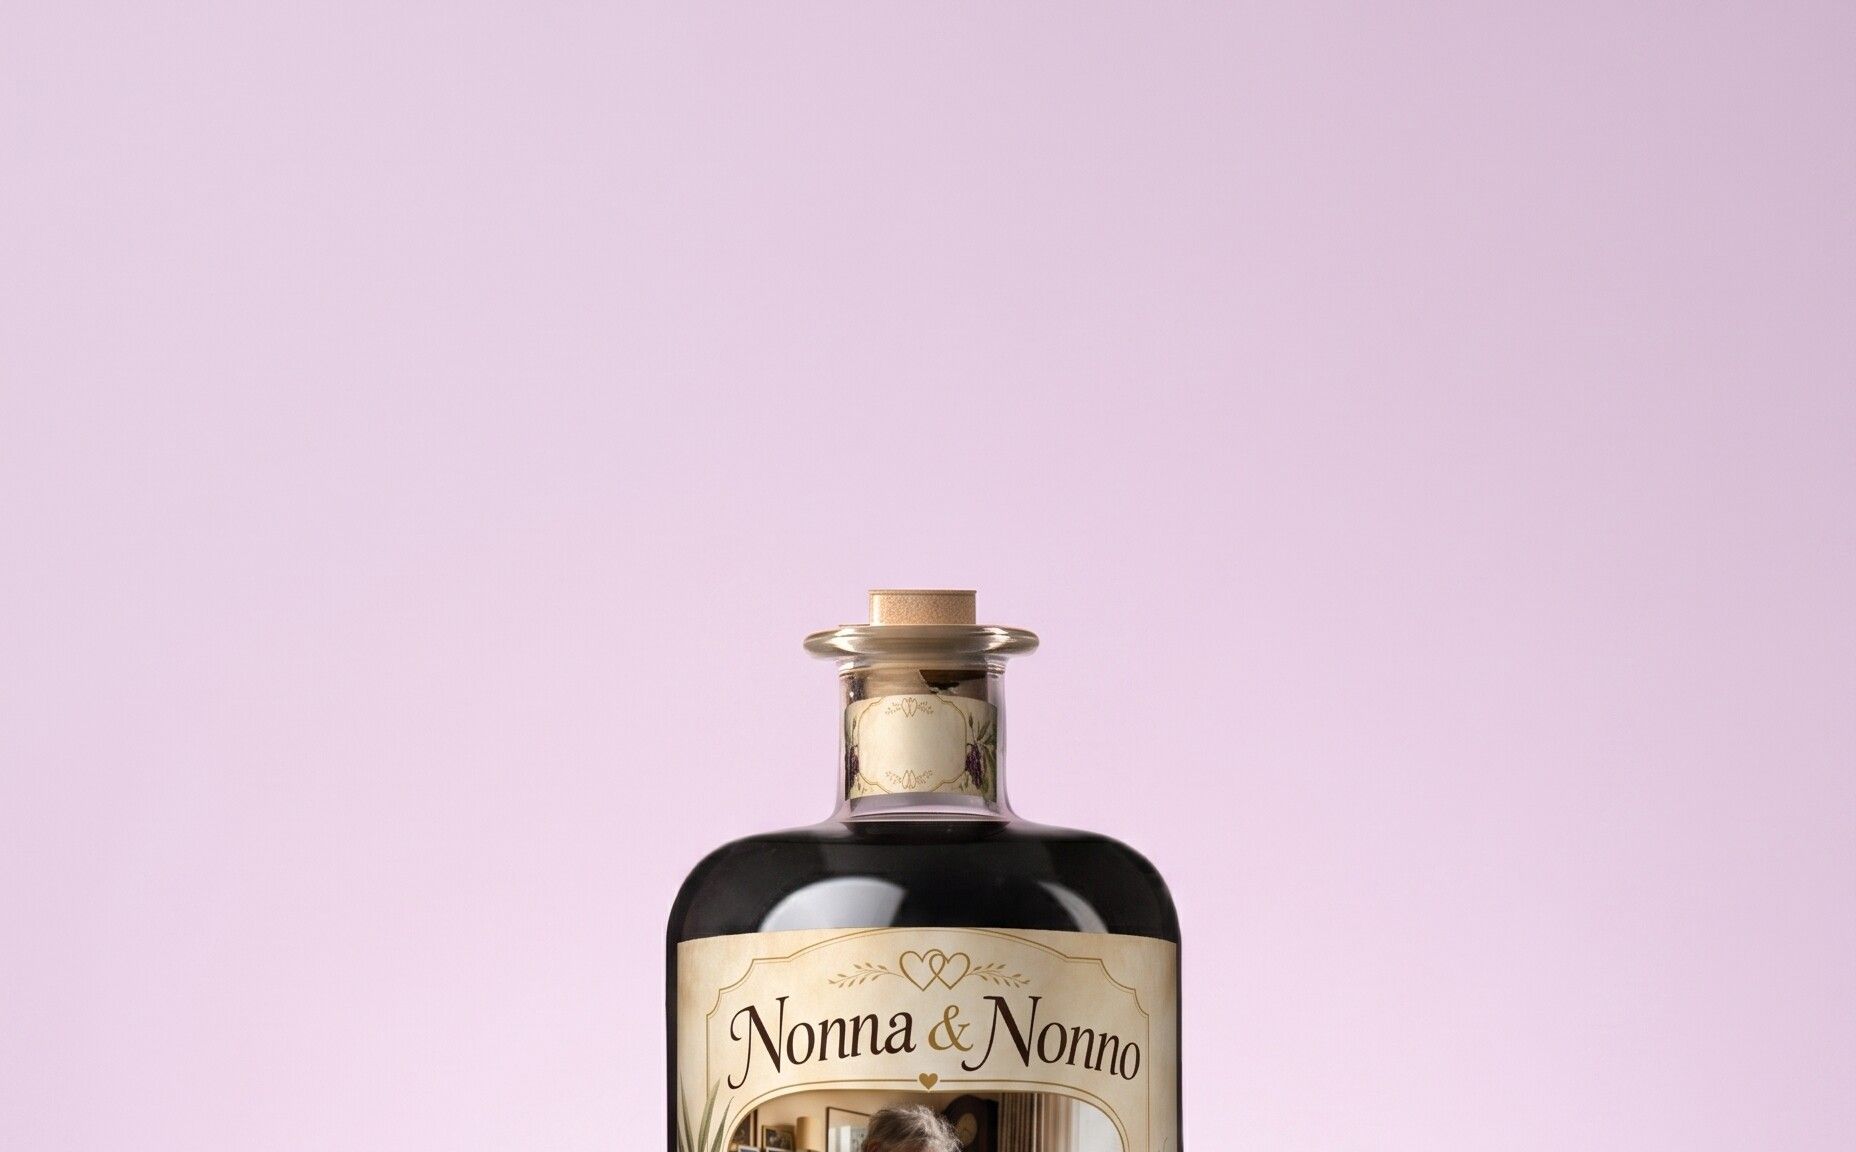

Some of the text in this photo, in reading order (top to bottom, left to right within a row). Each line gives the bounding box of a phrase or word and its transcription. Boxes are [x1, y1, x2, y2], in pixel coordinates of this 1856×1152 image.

[728, 996, 1140, 1089] Nonna & Nonno
